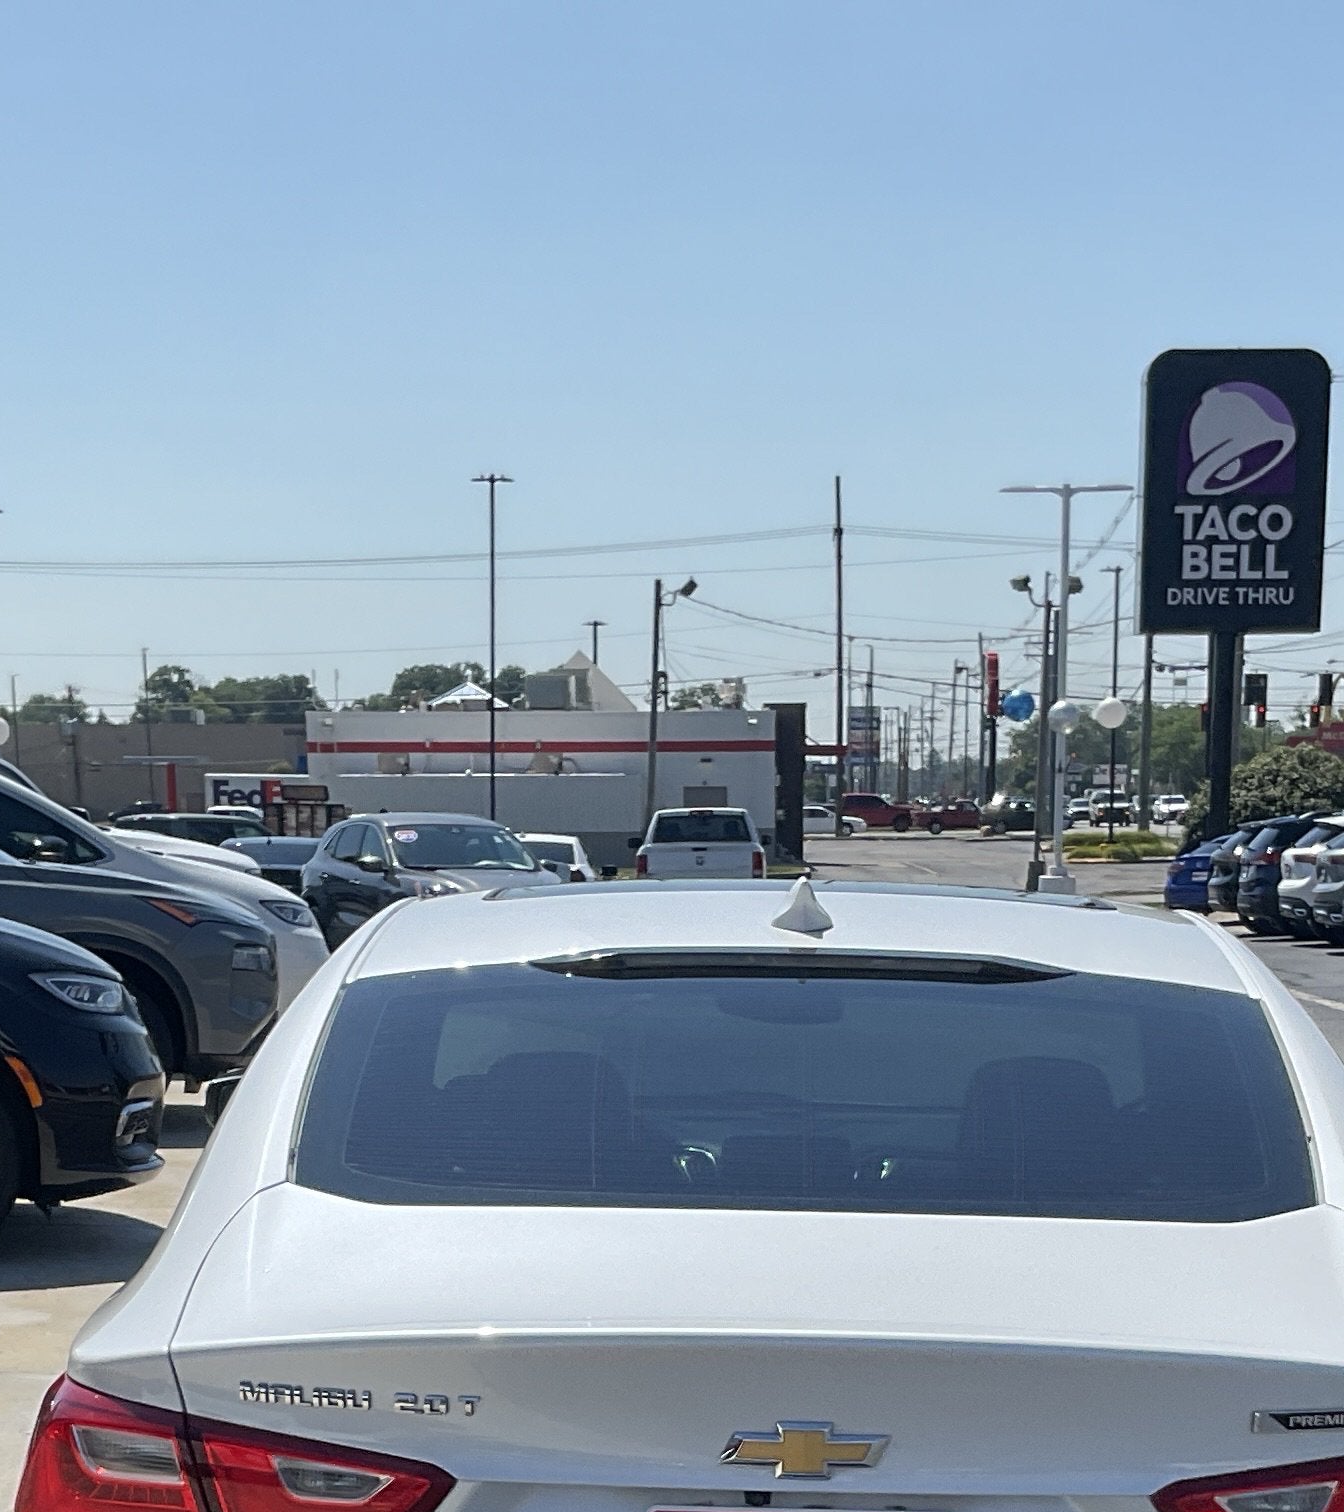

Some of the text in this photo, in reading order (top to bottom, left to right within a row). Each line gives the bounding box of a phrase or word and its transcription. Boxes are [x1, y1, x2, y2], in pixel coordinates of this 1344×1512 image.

[1174, 504, 1293, 541] TACO
[1181, 544, 1289, 580] BELL
[1166, 587, 1294, 606] DRIVE THRU
[239, 1380, 372, 1411] MALIBU
